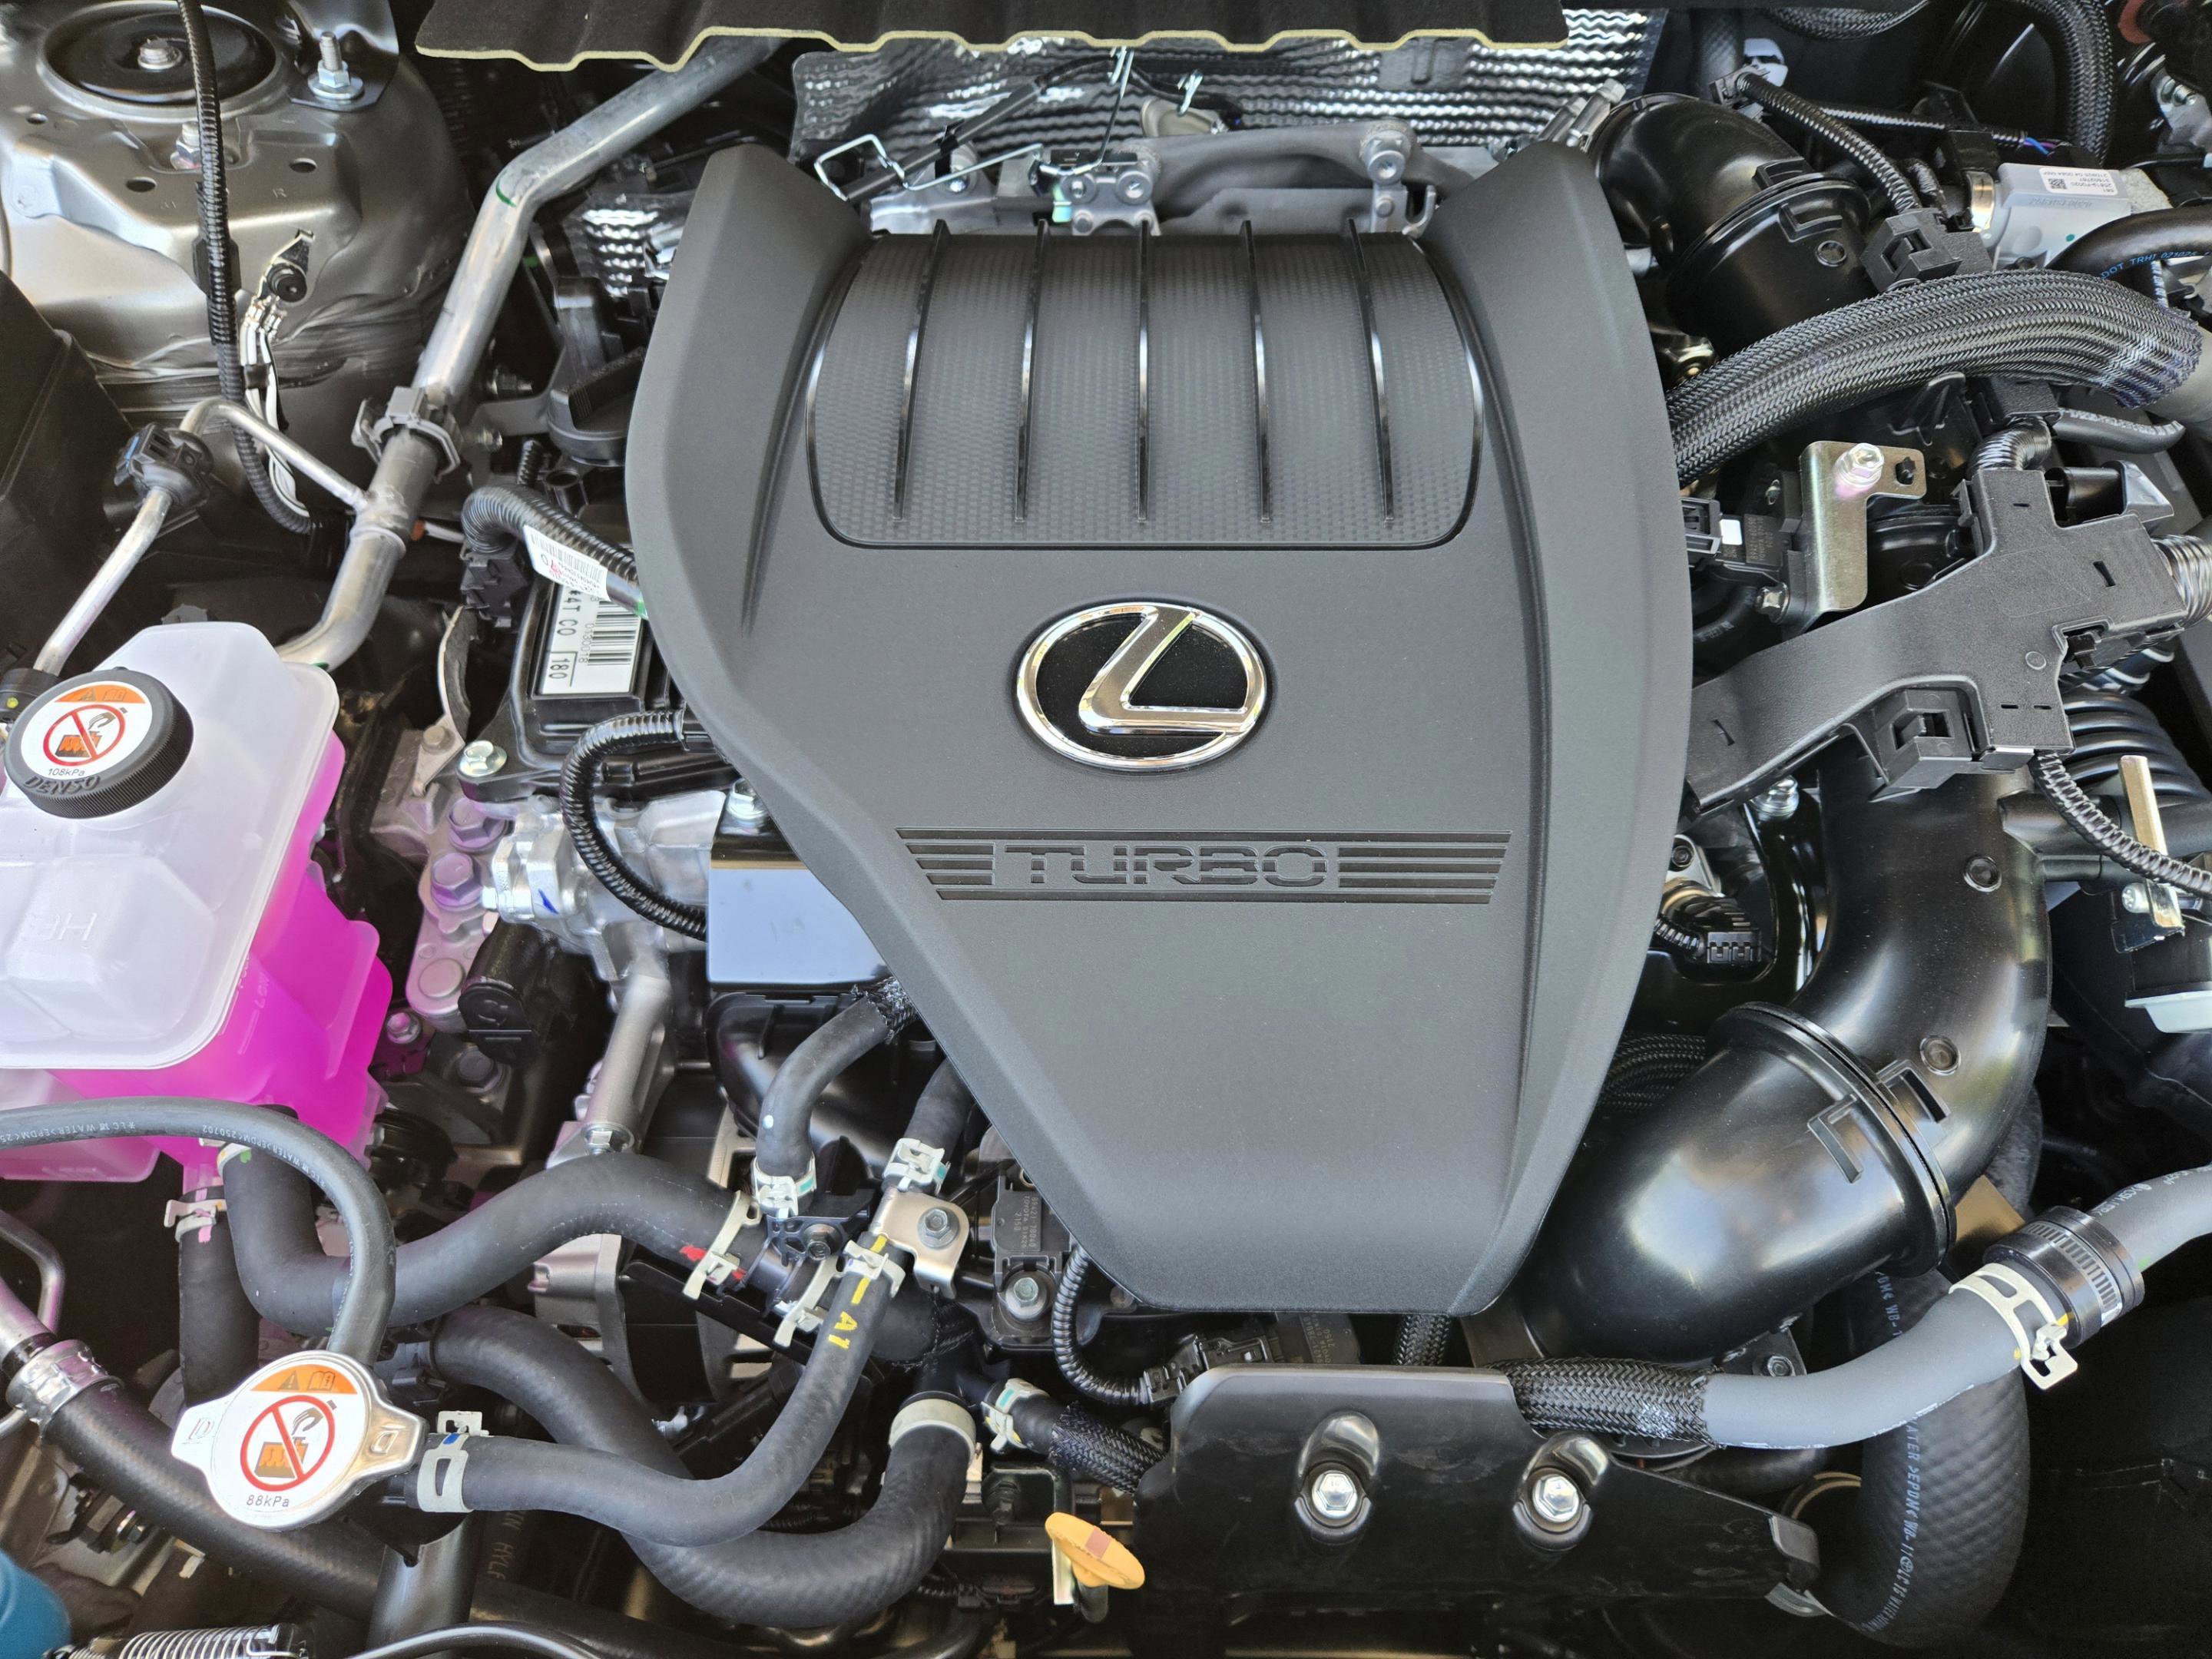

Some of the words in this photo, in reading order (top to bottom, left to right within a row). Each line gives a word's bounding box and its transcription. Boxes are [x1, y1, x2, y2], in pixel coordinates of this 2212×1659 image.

[578, 622, 595, 664] 0130018
[548, 657, 571, 680] 180
[48, 767, 86, 777] 108kPa
[25, 774, 101, 796] DENSO
[1004, 845, 1327, 888] TURBO
[828, 1310, 858, 1349] A1
[245, 1493, 292, 1509] 88kPa
